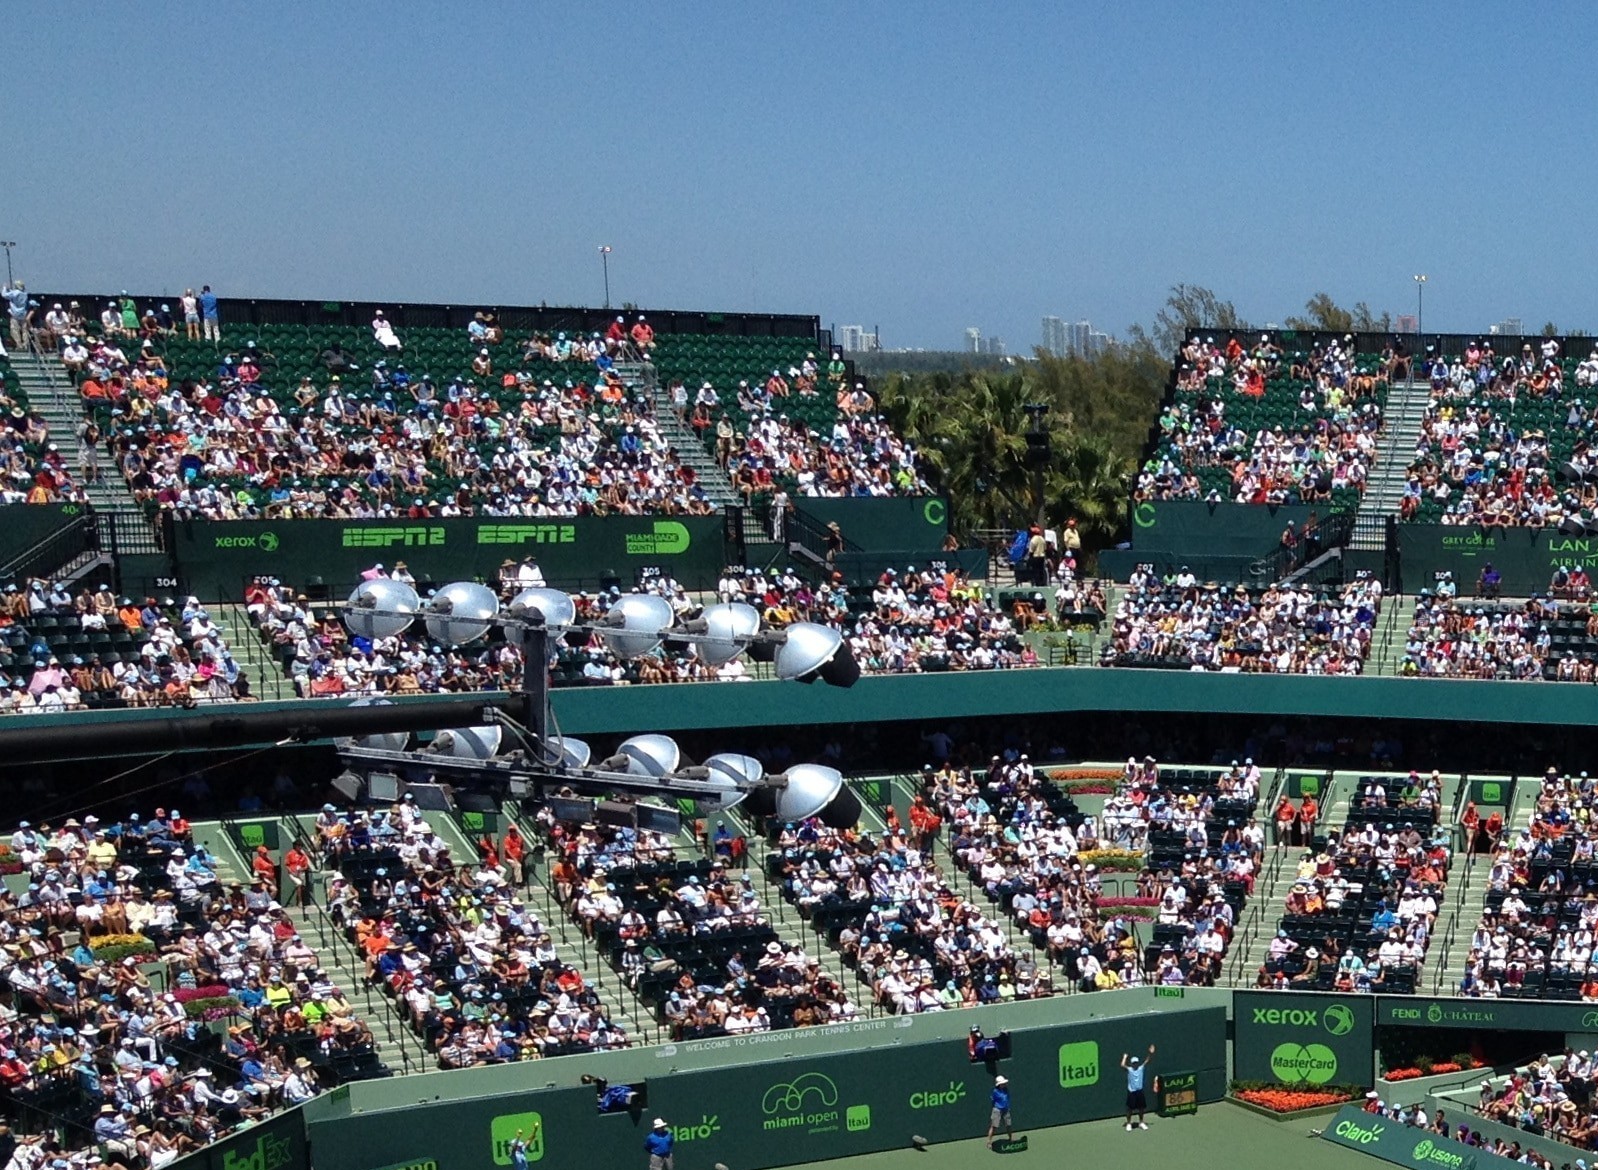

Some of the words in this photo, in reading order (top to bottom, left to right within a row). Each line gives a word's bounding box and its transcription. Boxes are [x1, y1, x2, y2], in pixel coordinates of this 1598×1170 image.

[924, 500, 944, 525] C
[1134, 502, 1156, 528] C
[216, 537, 256, 547] xerox
[1442, 537, 1463, 545] GREY
[1549, 539, 1589, 551] LAN
[157, 578, 177, 587] 304
[1253, 1008, 1318, 1026] xerox
[1392, 1008, 1421, 1019] FENDI
[685, 1038, 730, 1053] WELCOME
[734, 1037, 746, 1046] TO
[749, 1031, 791, 1045] CRANDON
[794, 1028, 816, 1039] PARK
[820, 1024, 850, 1036] TENNIS
[854, 1021, 887, 1033] CENTER
[1272, 1055, 1335, 1070] MasterCard
[1062, 1062, 1096, 1082] Itaú
[909, 1091, 958, 1110] Claro
[763, 1115, 804, 1129] miami
[806, 1112, 838, 1126] open
[848, 1115, 869, 1128] Itaú
[667, 1124, 712, 1142] laro
[1335, 1120, 1374, 1144] Claro
[496, 1133, 541, 1158] Itú
